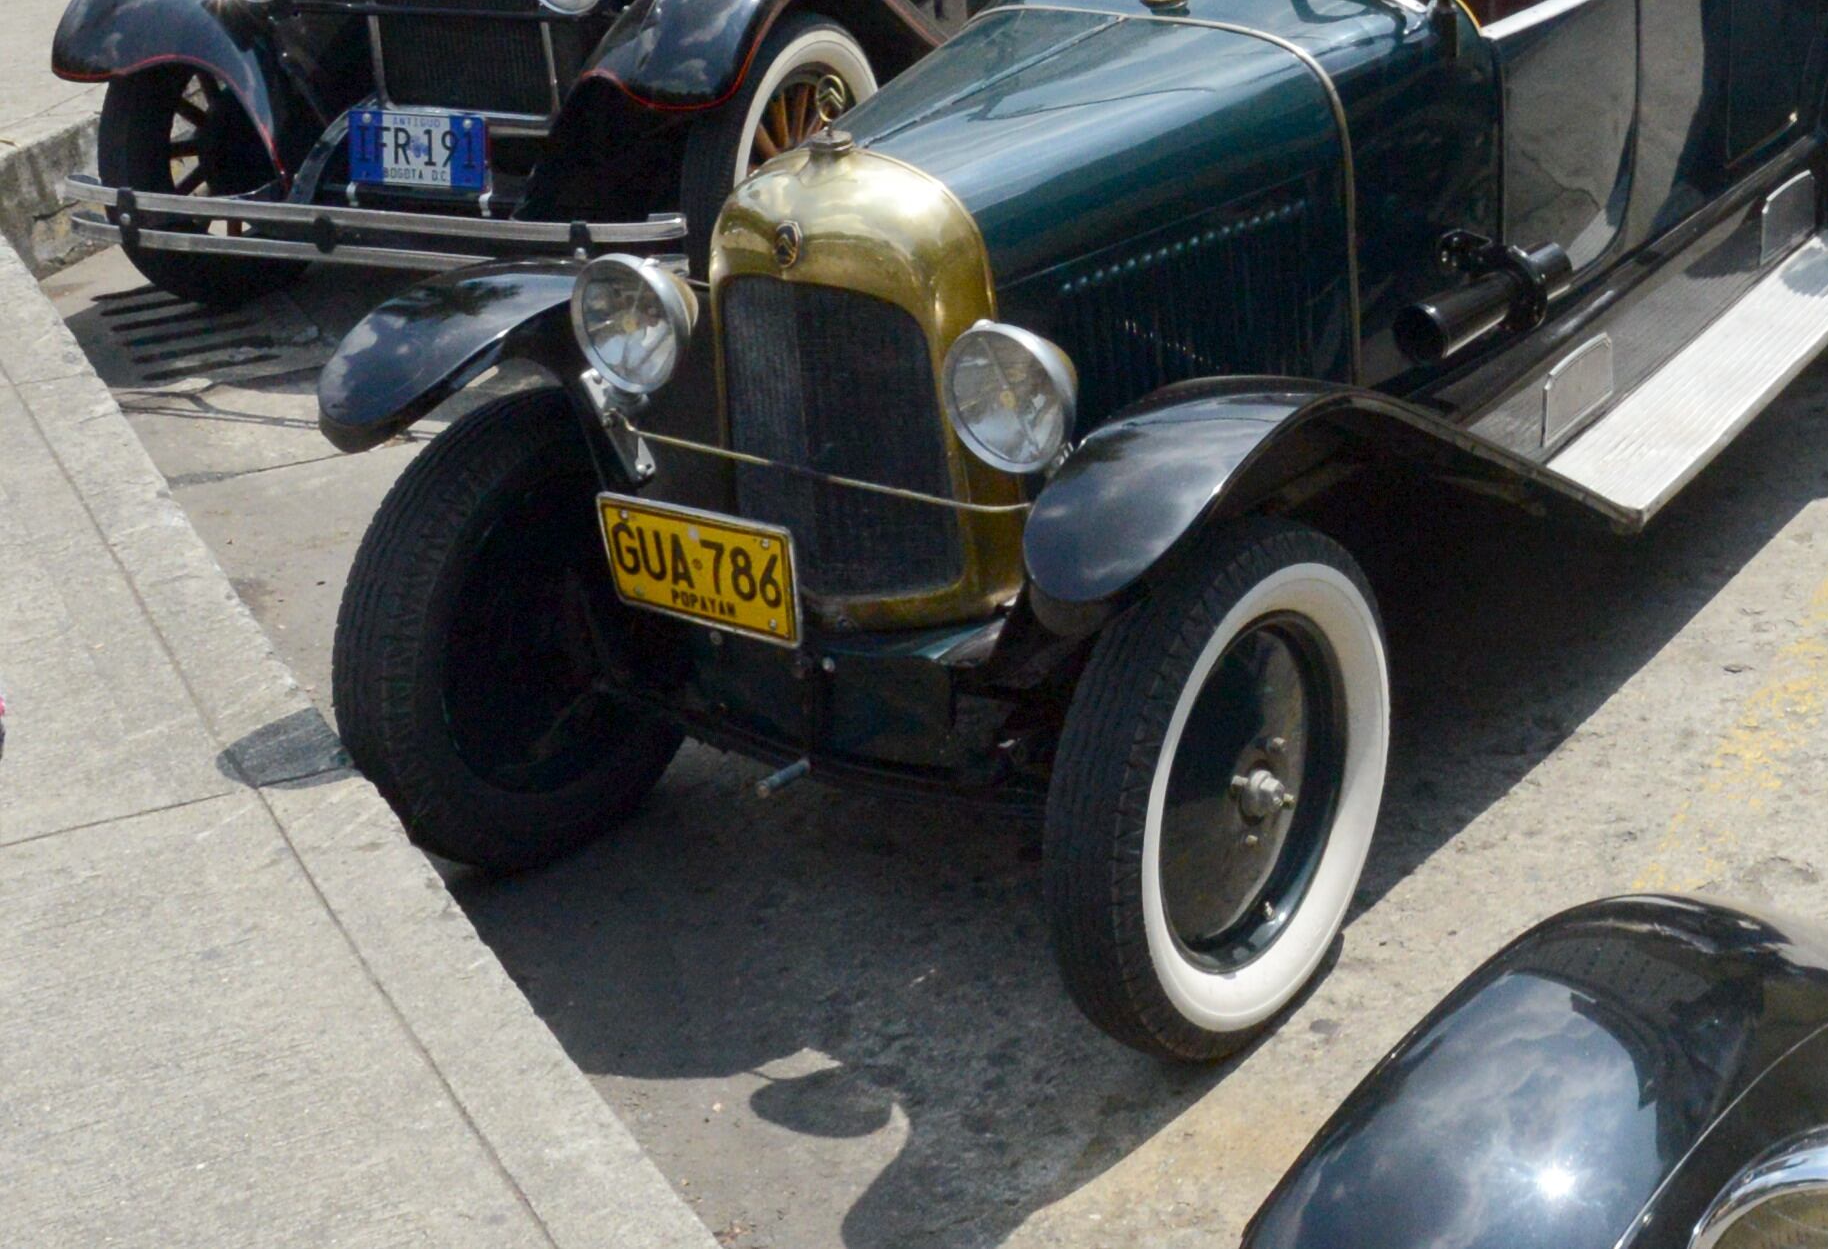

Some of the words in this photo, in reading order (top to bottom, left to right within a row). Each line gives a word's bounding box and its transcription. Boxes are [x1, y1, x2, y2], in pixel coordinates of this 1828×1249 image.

[392, 116, 441, 129] ANTIGUO
[383, 167, 424, 181] BOGOTA
[670, 588, 738, 618] POPAYAN
